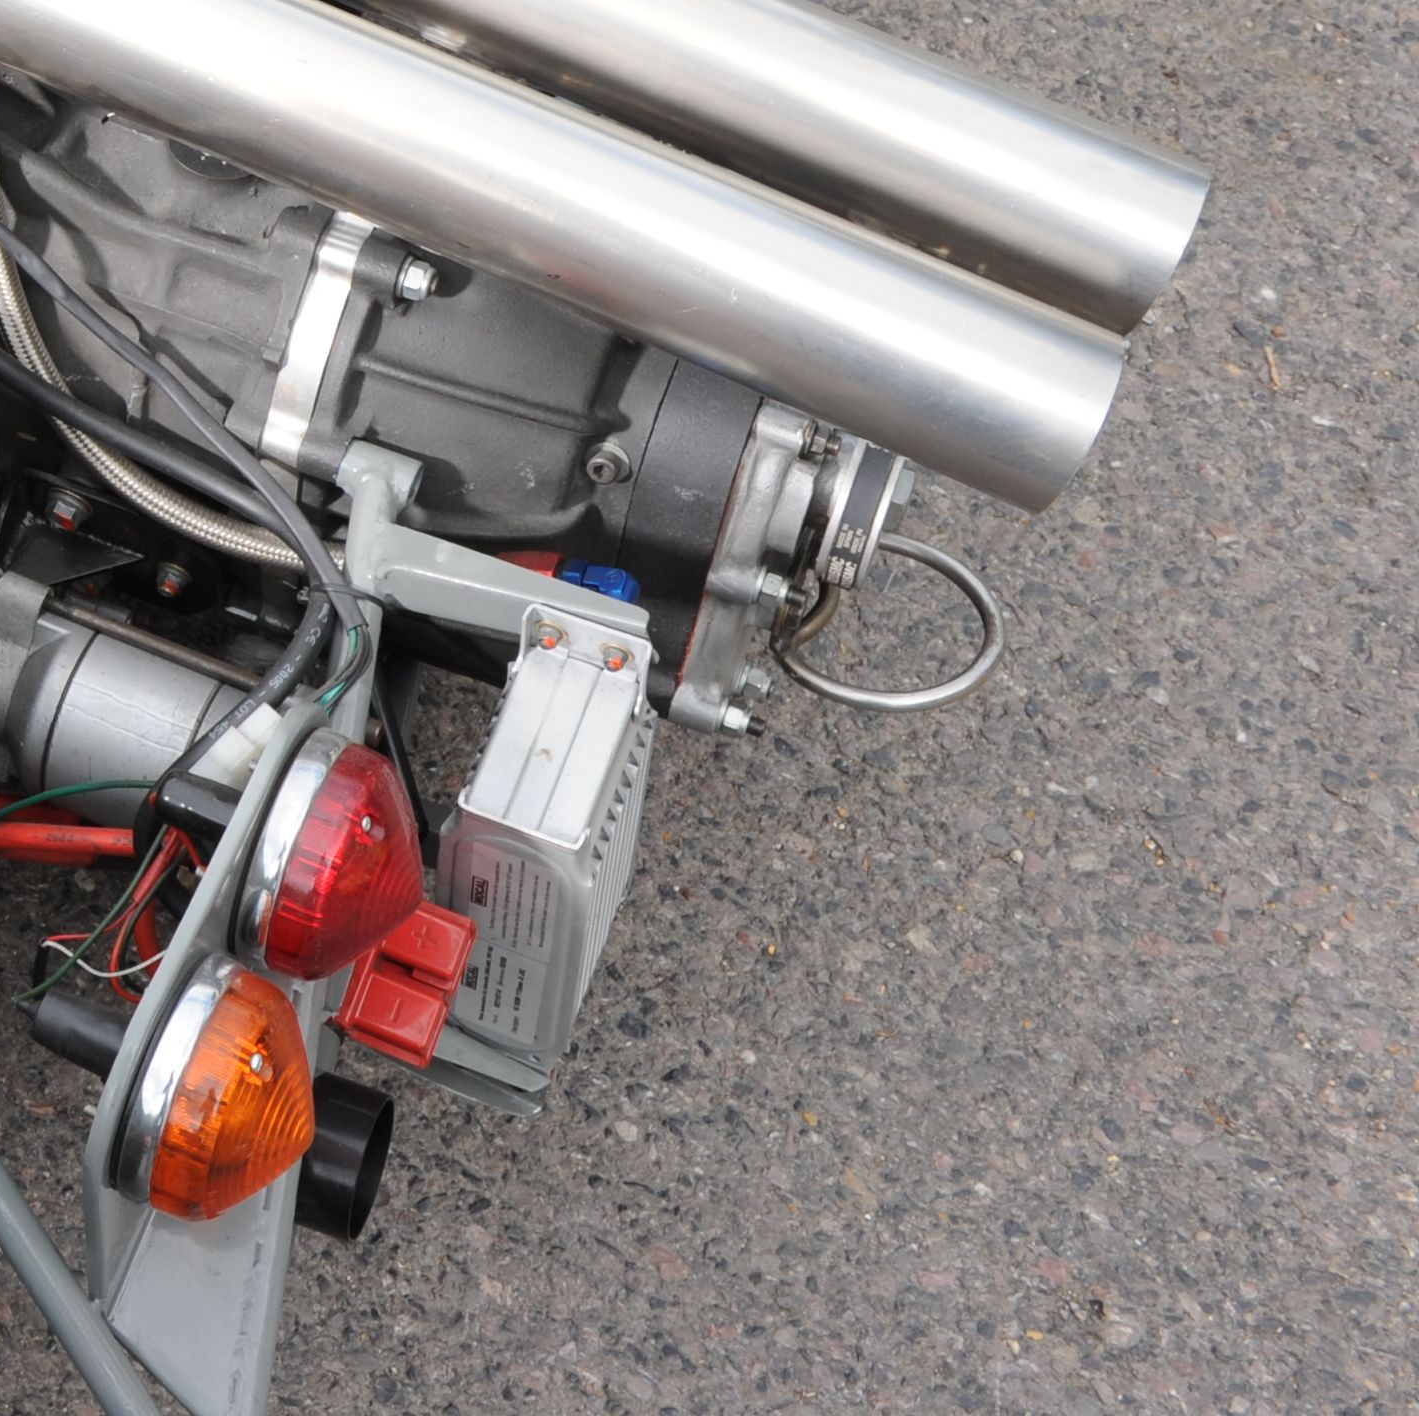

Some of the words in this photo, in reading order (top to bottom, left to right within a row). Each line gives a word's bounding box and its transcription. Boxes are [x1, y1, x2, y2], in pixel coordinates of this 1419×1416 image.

[264, 661, 297, 692] 2005
[233, 697, 257, 720] LOT
[471, 876, 487, 906] MOCAL
